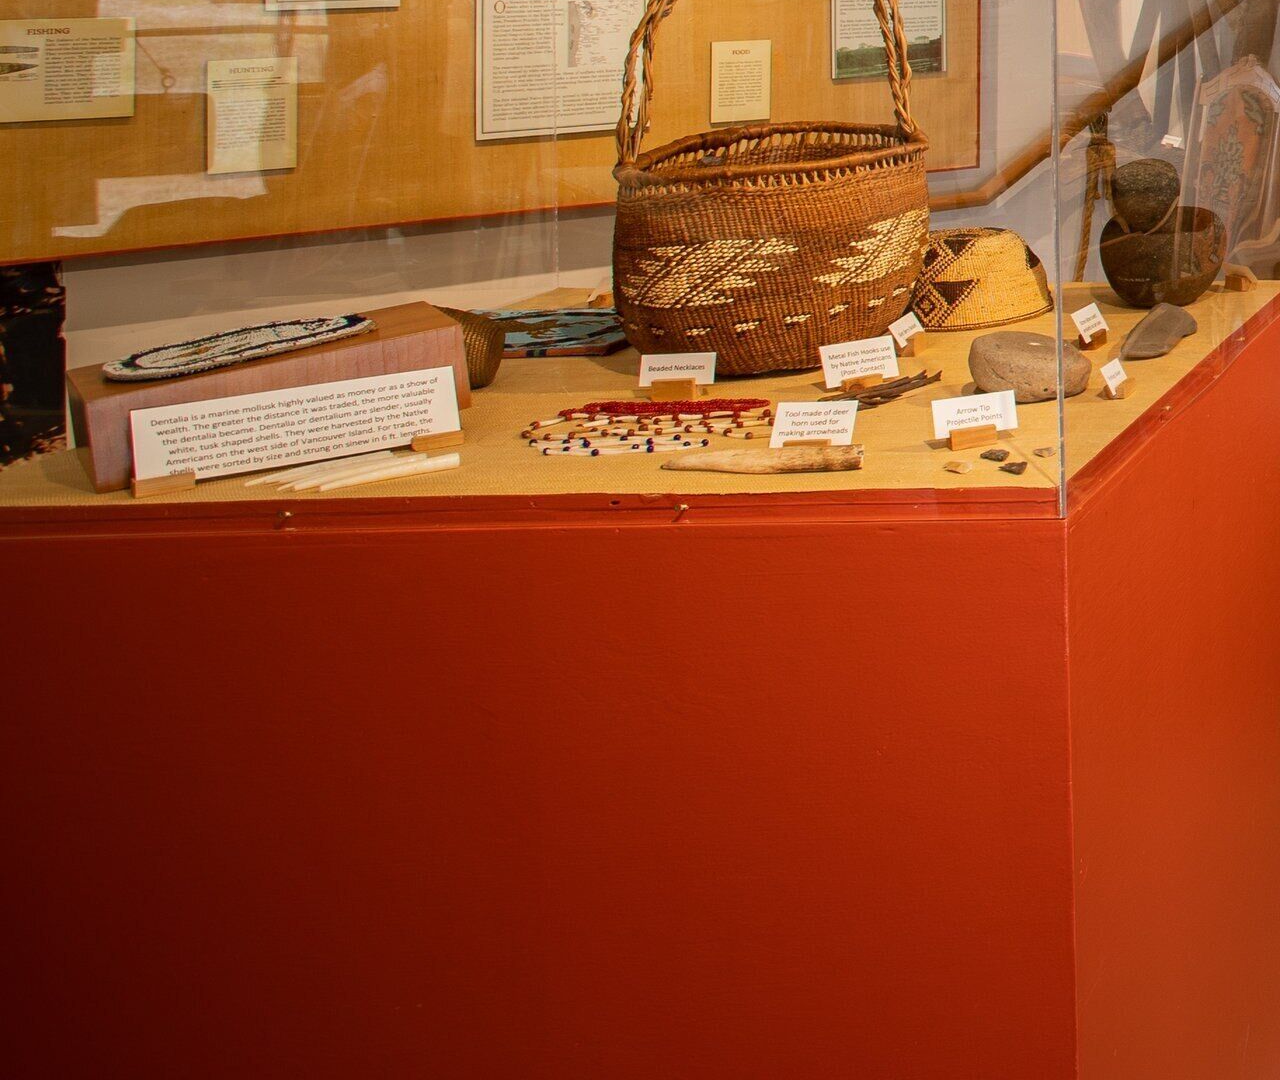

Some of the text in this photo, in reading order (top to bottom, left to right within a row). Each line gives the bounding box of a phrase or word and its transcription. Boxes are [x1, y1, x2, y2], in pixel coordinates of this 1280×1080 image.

[27, 28, 70, 36] FISHING
[648, 365, 672, 373] Beaded
[151, 416, 188, 427] Dentalia
[208, 409, 240, 419] marine
[242, 403, 275, 414] mollusk
[278, 398, 304, 409] highly
[306, 394, 334, 404] valued
[348, 387, 376, 397] money
[406, 379, 428, 389] show
[157, 426, 190, 436] wealth.
[212, 419, 244, 430] greater
[264, 409, 300, 420] distance
[311, 405, 327, 413] was
[329, 400, 359, 410] traded,
[377, 394, 399, 402] more
[401, 387, 435, 399] valuable
[162, 438, 178, 446] the
[180, 431, 217, 443] dentalia
[219, 427, 256, 438] became.
[259, 420, 295, 431] Dentalia
[308, 411, 352, 424] dentalium
[369, 404, 402, 414] slender,
[404, 398, 432, 408] usually
[946, 411, 1003, 426] Projectile Points
[956, 403, 991, 415] Arrow Tip
[166, 453, 214, 466] Americans
[247, 445, 268, 454] west
[270, 442, 288, 450] side
[290, 439, 299, 447] of
[301, 433, 346, 445] Vancouver
[348, 427, 375, 437] Island.
[393, 420, 417, 431] trade,
[169, 445, 197, 455] white,
[200, 443, 219, 451] tusk
[221, 437, 253, 449] shaped
[255, 433, 280, 442] shells.
[285, 429, 305, 438] They
[308, 425, 329, 433] were
[331, 418, 373, 430] harvested
[374, 415, 385, 423] by
[402, 408, 428, 418] Native
[779, 429, 804, 437] making
[197, 462, 221, 471] were
[222, 457, 250, 468] sorted
[253, 455, 263, 465] by
[266, 451, 282, 459] size
[284, 449, 300, 457] and
[303, 444, 331, 454] strung
[333, 442, 343, 450] on
[345, 437, 370, 447] sinew
[389, 432, 397, 440] ft.
